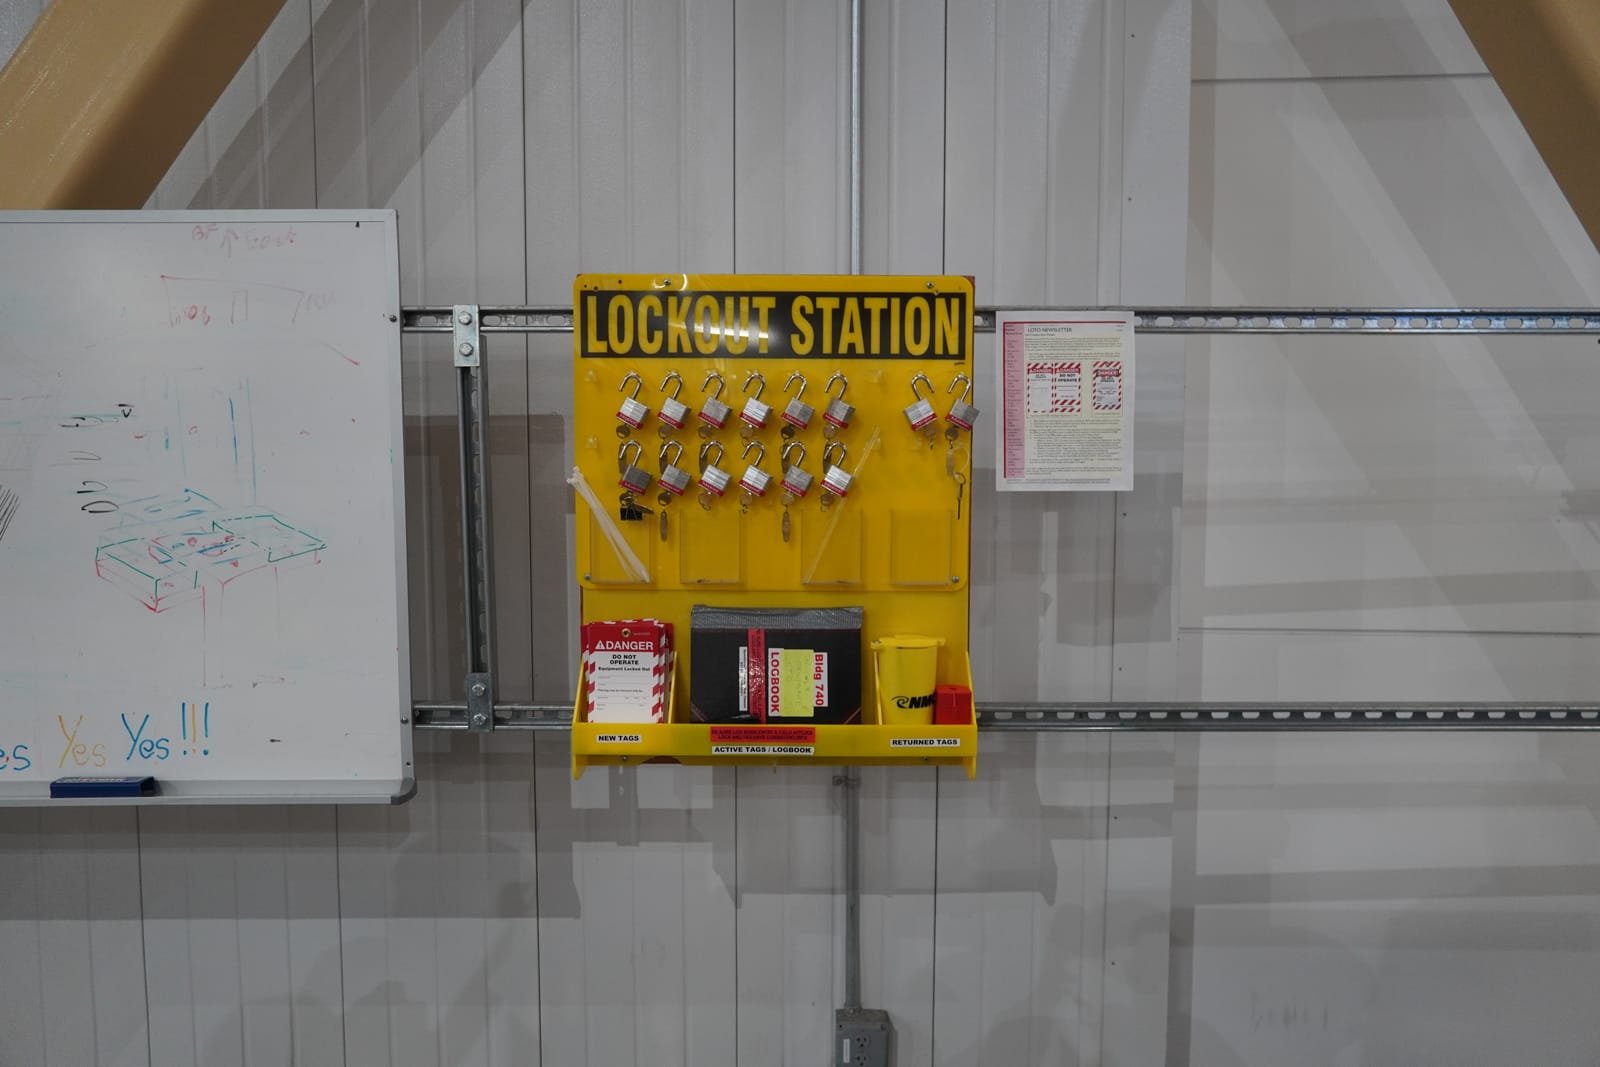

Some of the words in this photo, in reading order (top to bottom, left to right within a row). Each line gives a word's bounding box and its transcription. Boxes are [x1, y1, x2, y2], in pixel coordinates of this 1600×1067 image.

[587, 294, 776, 355] LOCKOUT
[790, 295, 960, 356] STATION
[605, 641, 654, 650] DANGER
[771, 652, 780, 712] LOGBOOK
[813, 654, 824, 680] Bldg
[815, 684, 824, 705] 740
[58, 714, 106, 768] Yes
